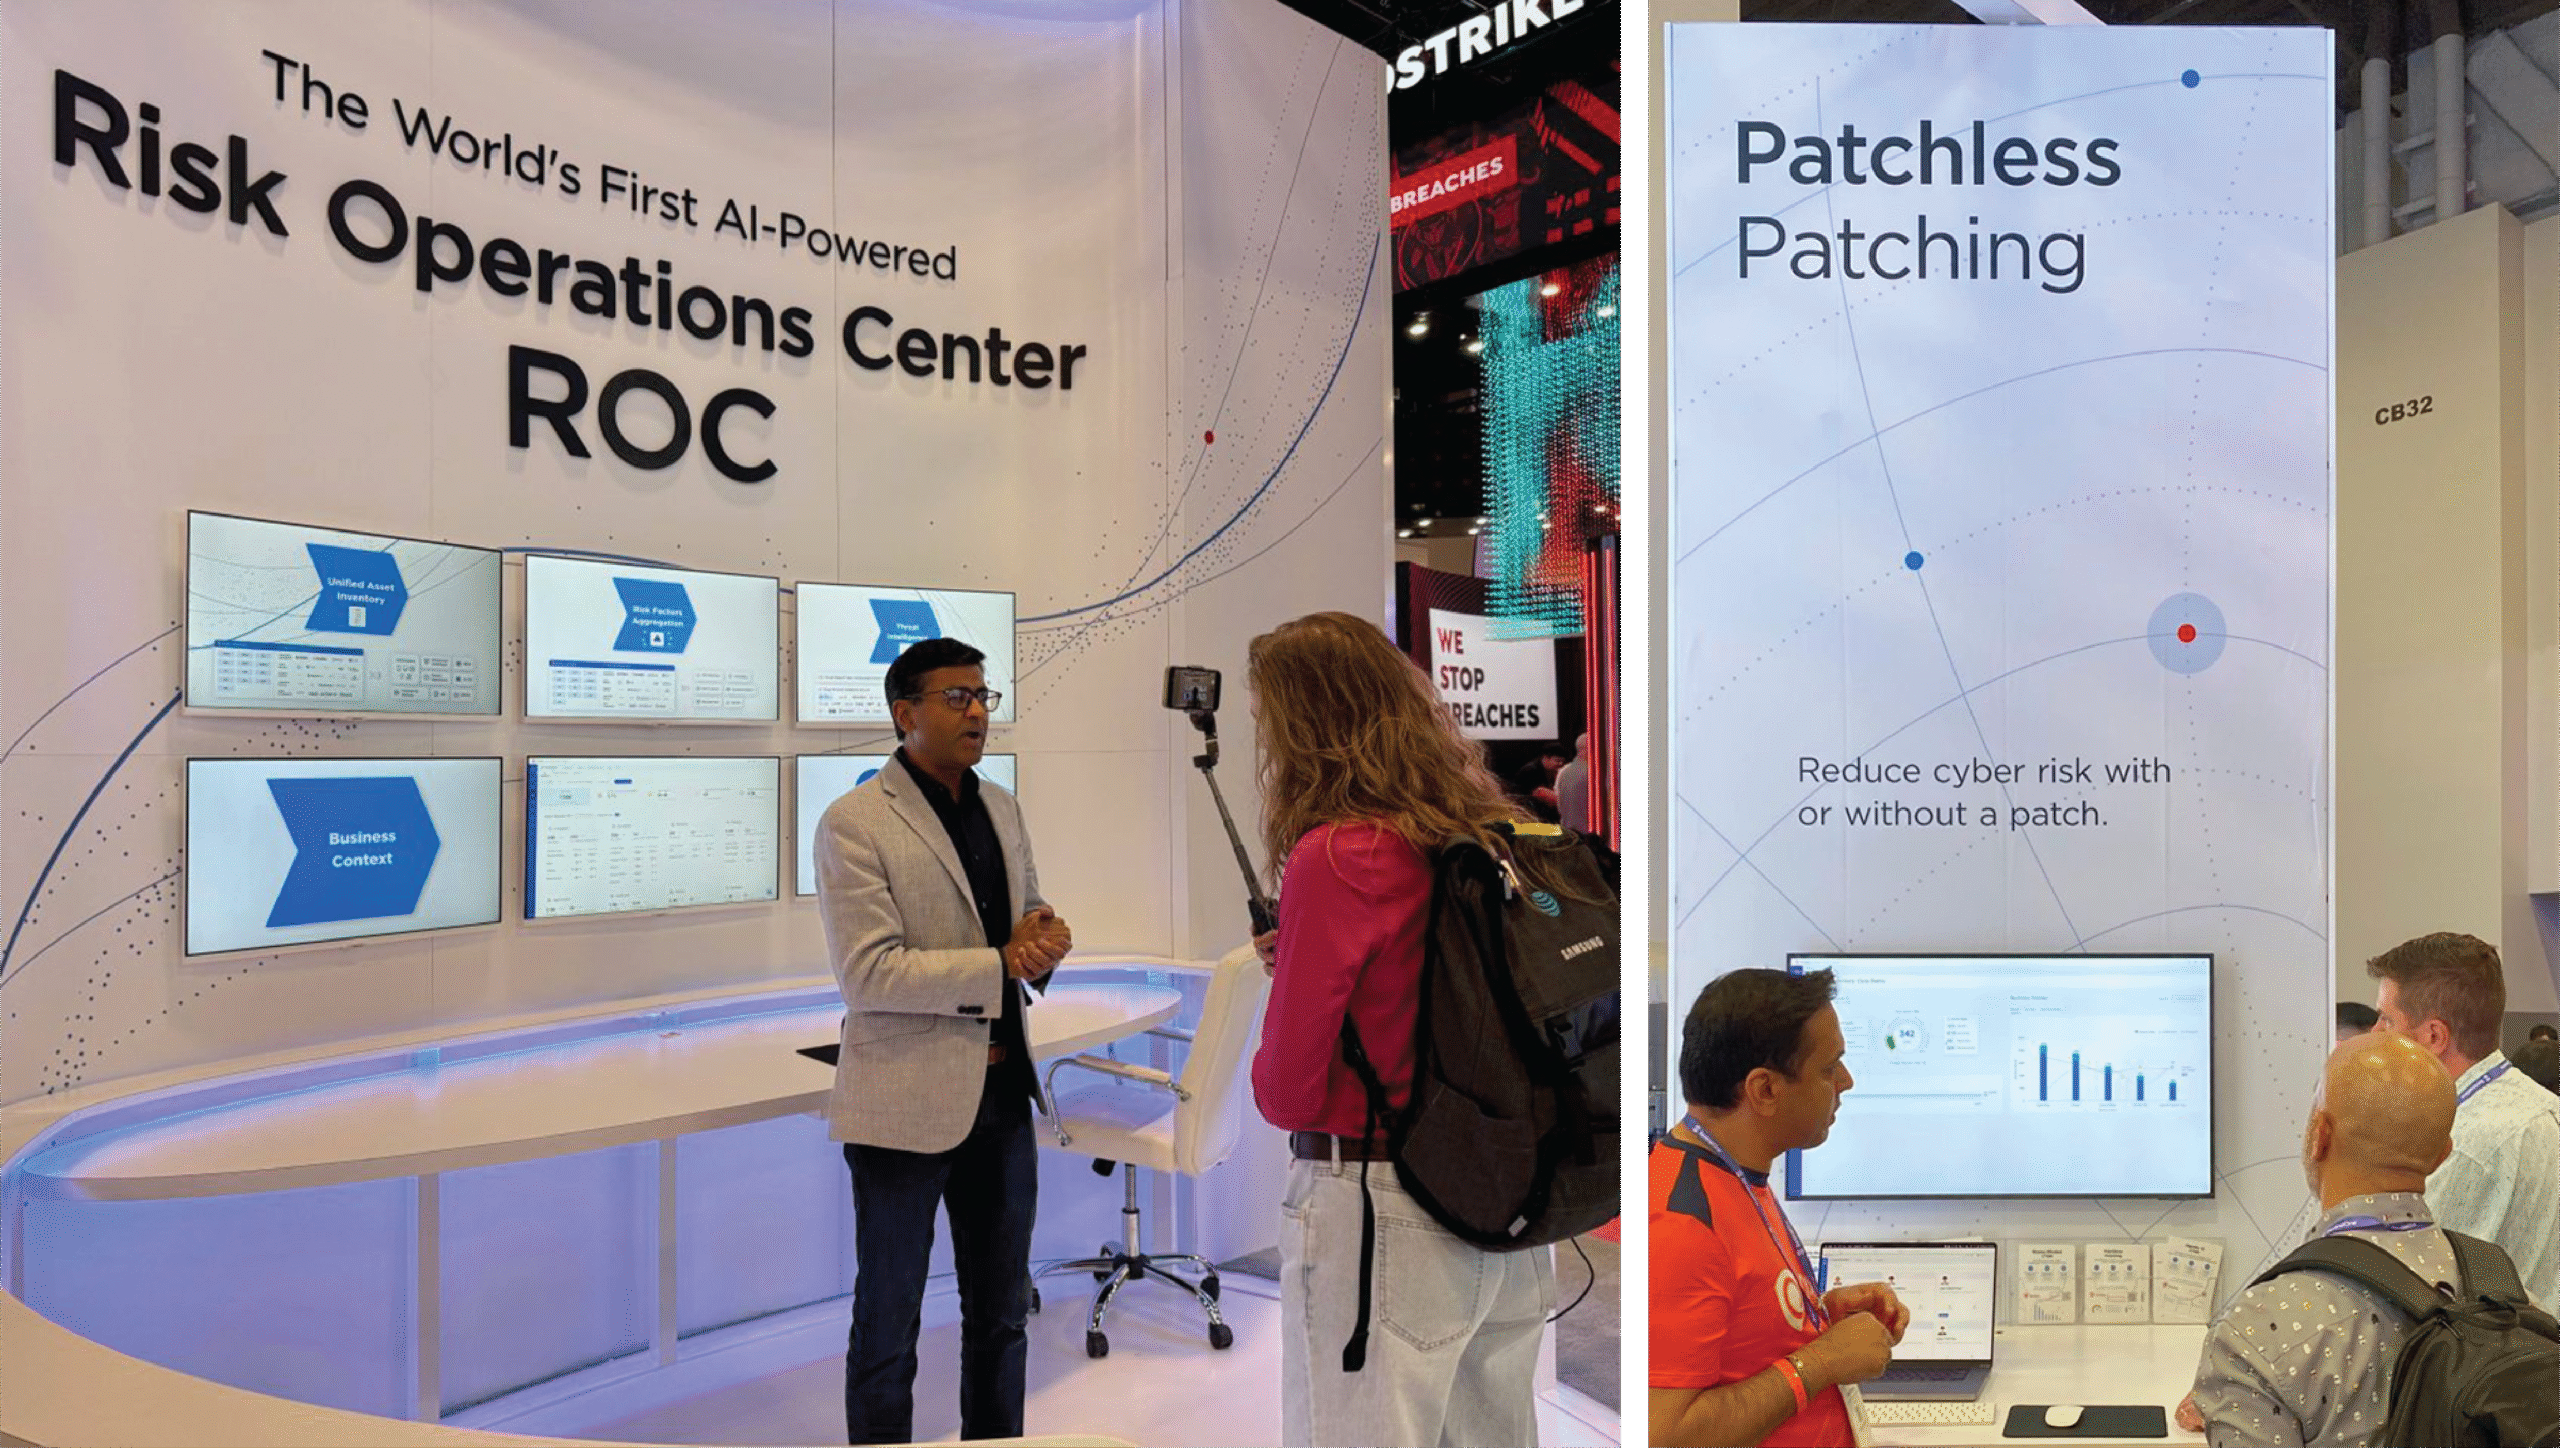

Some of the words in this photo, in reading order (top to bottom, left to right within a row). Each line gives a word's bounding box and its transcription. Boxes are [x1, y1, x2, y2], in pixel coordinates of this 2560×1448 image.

[1387, 0, 1585, 94] STRIK
[261, 49, 369, 129] The
[392, 98, 581, 195] World's
[601, 164, 698, 227] First
[715, 199, 957, 280] AI-Powered
[1737, 119, 2122, 187] Patchless
[1390, 156, 1504, 214] BREACHES
[55, 69, 289, 237] Risk
[327, 179, 815, 358] Operations
[843, 306, 1087, 390] Center
[1738, 214, 2086, 294] Patching
[508, 344, 779, 484] ROC
[2375, 395, 2433, 426] CB32
[327, 577, 365, 589] Unified
[367, 582, 395, 592] Asset
[336, 591, 386, 605] Inventory
[1437, 627, 1464, 655] WE
[1440, 665, 1485, 692] STOP
[1442, 702, 1540, 728] REACHES
[1799, 756, 1921, 784] Reduce
[1933, 756, 2026, 789] cyber
[2038, 756, 2092, 784] risk
[2105, 756, 2171, 784] with
[1798, 804, 1833, 827] or
[1845, 800, 1967, 827] without
[1979, 805, 1998, 827] a
[2011, 800, 2108, 831] patch.
[328, 831, 397, 846] Business
[332, 852, 393, 868] Context
[1560, 936, 1604, 961] SAMSUNG
